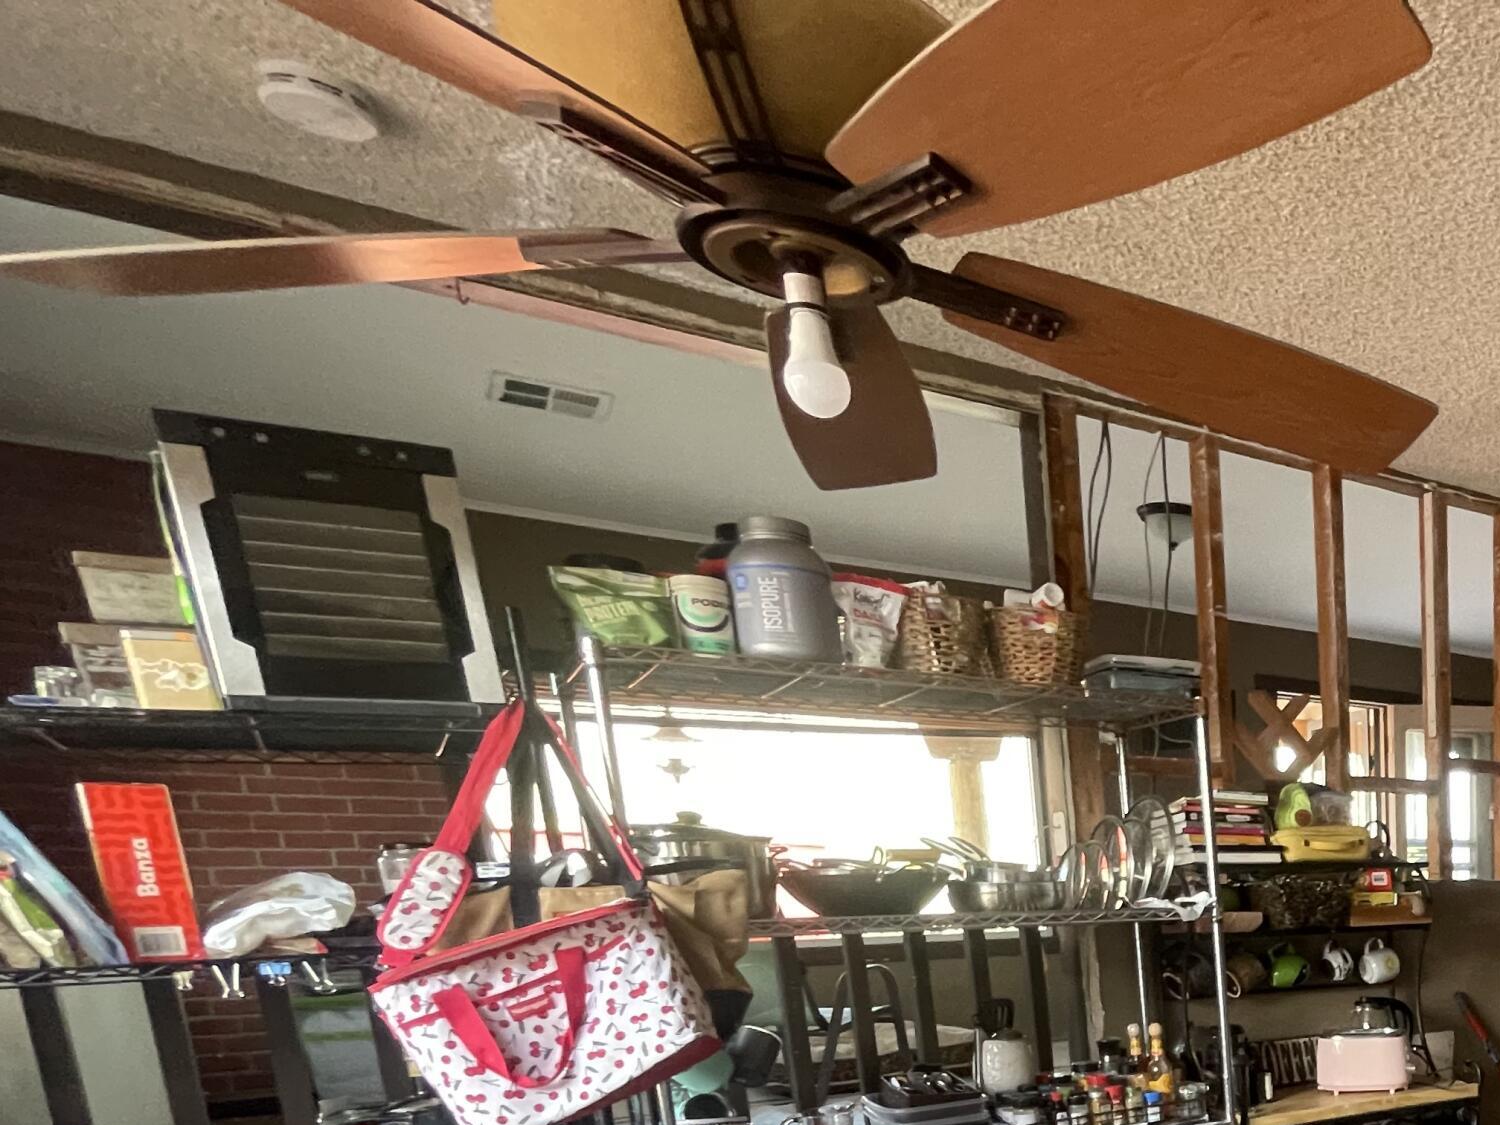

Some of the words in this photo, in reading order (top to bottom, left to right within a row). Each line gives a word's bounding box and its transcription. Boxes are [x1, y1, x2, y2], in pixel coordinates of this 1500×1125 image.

[757, 575, 785, 633] ISOPURE
[131, 837, 160, 897] Banza
[1260, 1037, 1317, 1084] OFFE
